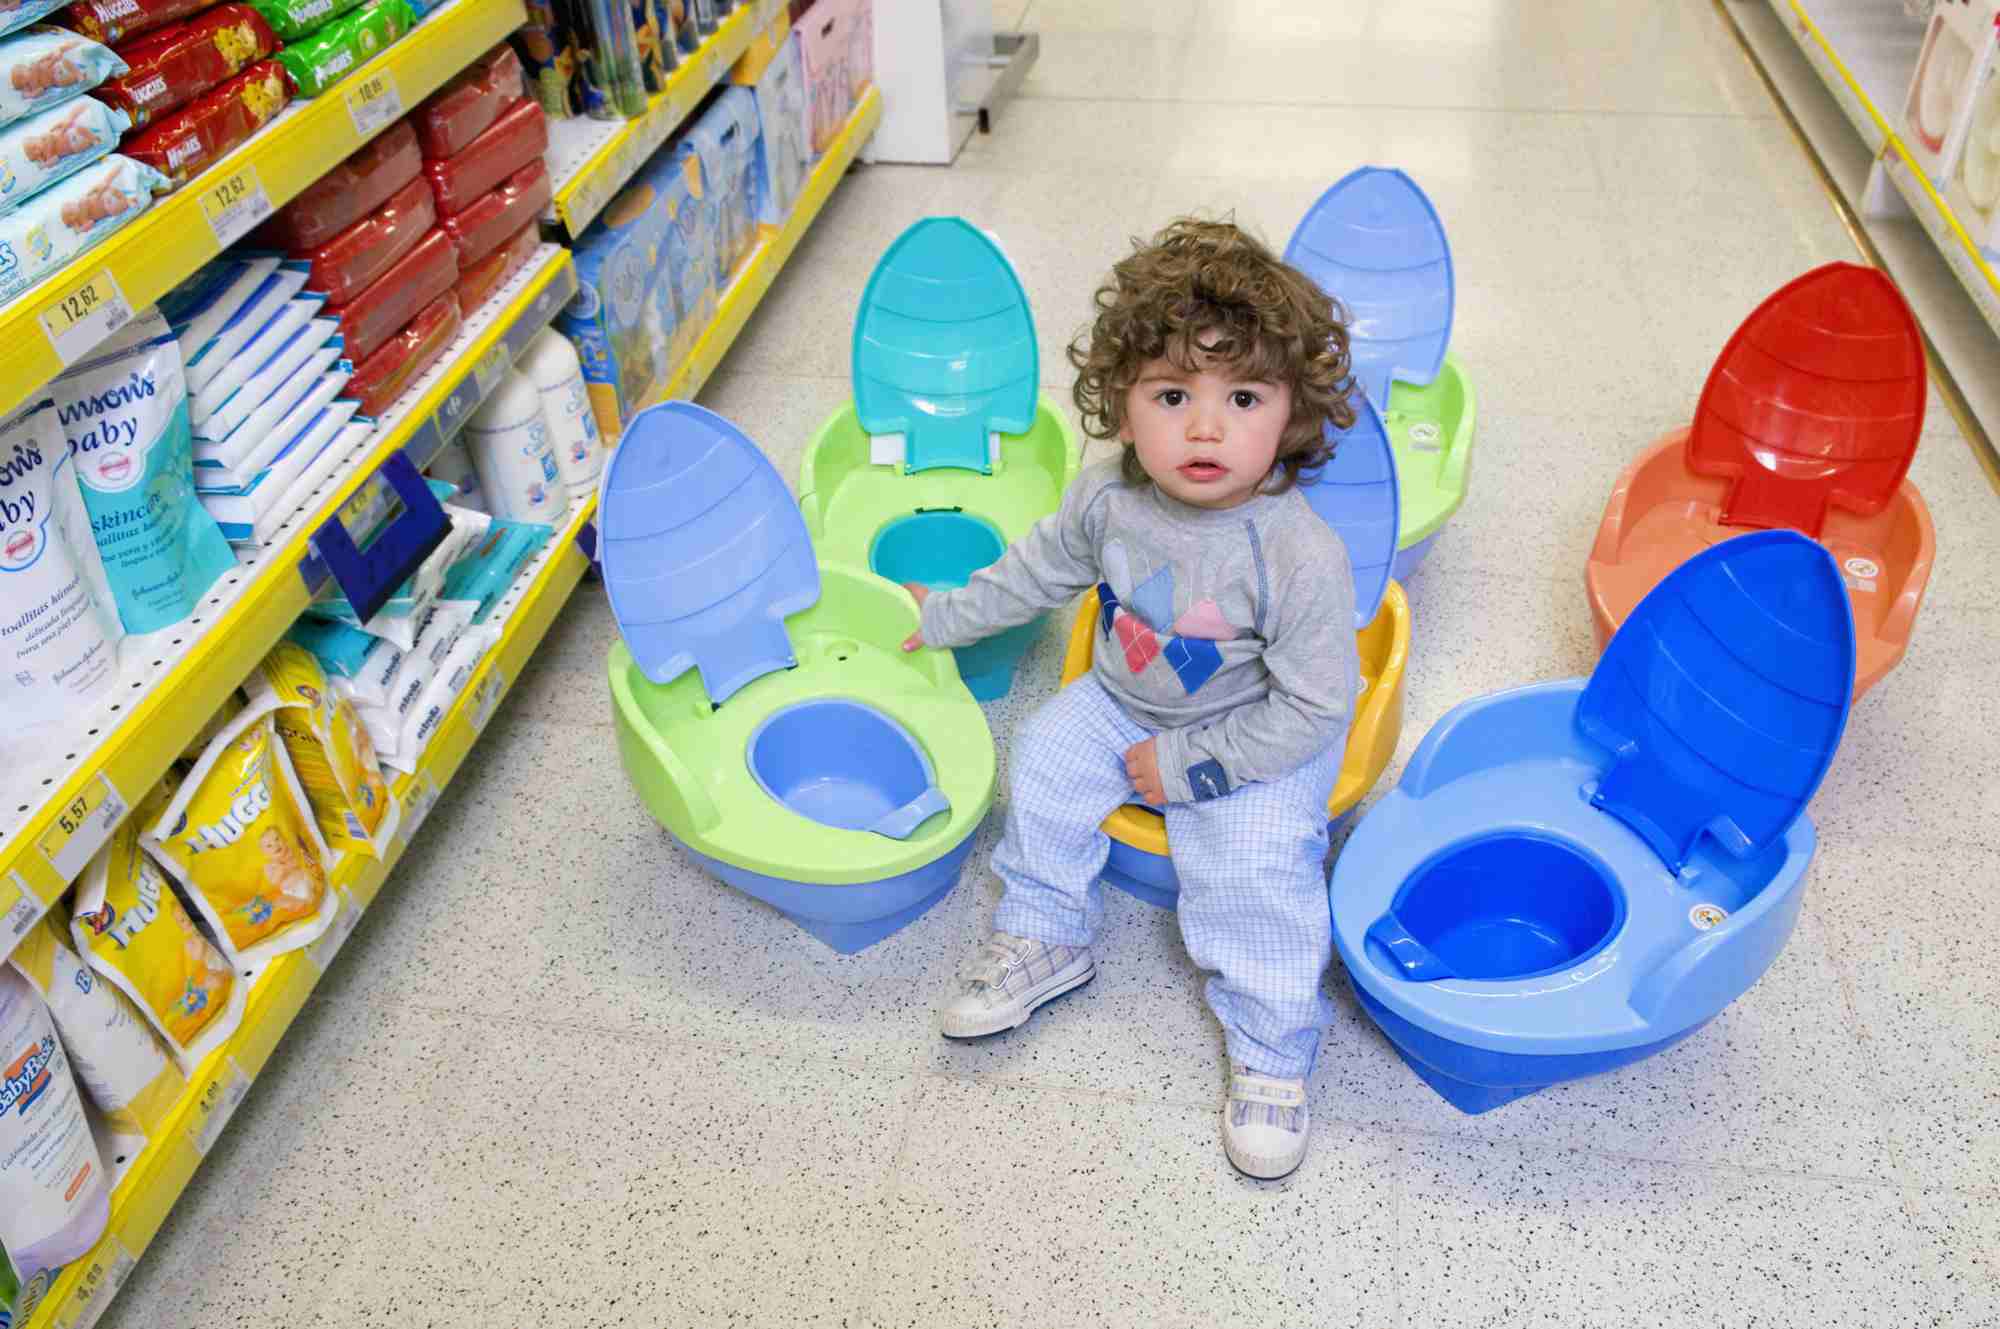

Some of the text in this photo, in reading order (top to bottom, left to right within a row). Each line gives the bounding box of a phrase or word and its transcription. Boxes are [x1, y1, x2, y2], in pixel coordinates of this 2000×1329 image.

[215, 175, 245, 208] 12,62
[61, 284, 98, 323] 12,62
[1, 600, 49, 637] toallitas
[60, 796, 87, 834] 5,57
